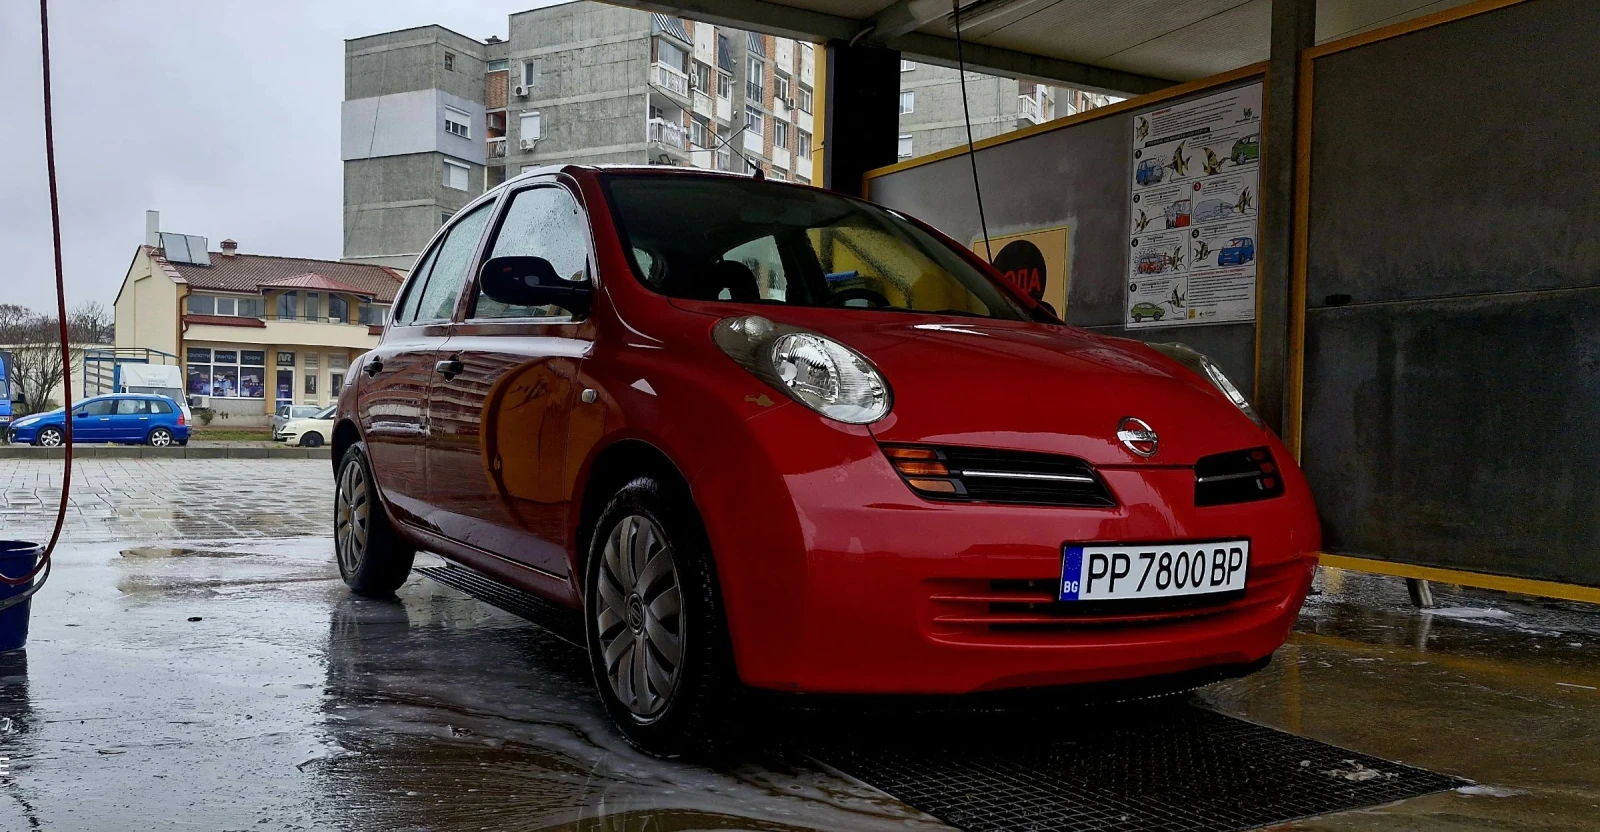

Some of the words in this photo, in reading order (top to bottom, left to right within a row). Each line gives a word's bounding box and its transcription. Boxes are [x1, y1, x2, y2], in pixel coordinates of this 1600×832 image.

[1086, 553, 1131, 593] PP
[1136, 550, 1206, 592] 7800
[1210, 547, 1243, 586] BP
[1063, 581, 1079, 593] BG
